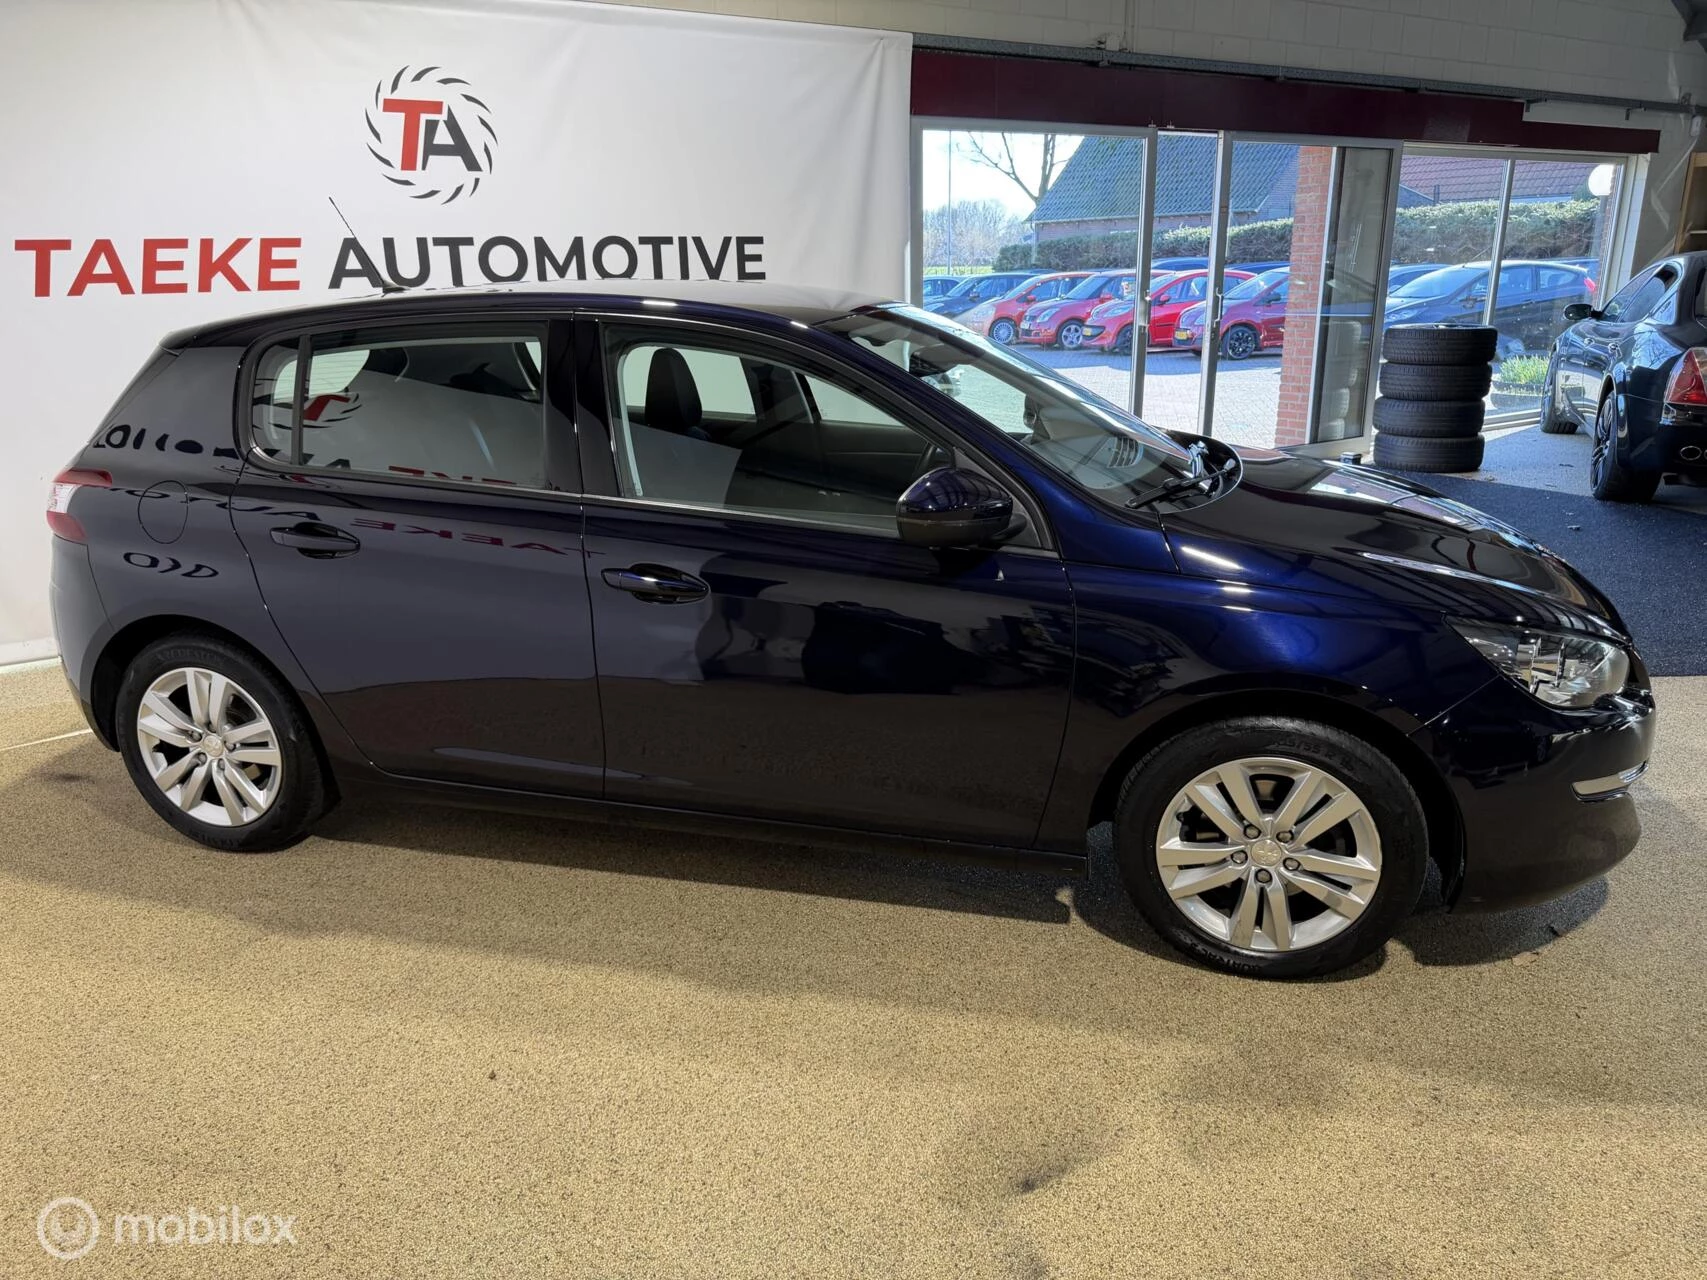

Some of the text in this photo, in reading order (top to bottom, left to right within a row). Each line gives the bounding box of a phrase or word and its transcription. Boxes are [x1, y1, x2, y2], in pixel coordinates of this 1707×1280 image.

[382, 98, 483, 172] TA
[14, 235, 766, 297] TAEKE AUTOMOTIVE
